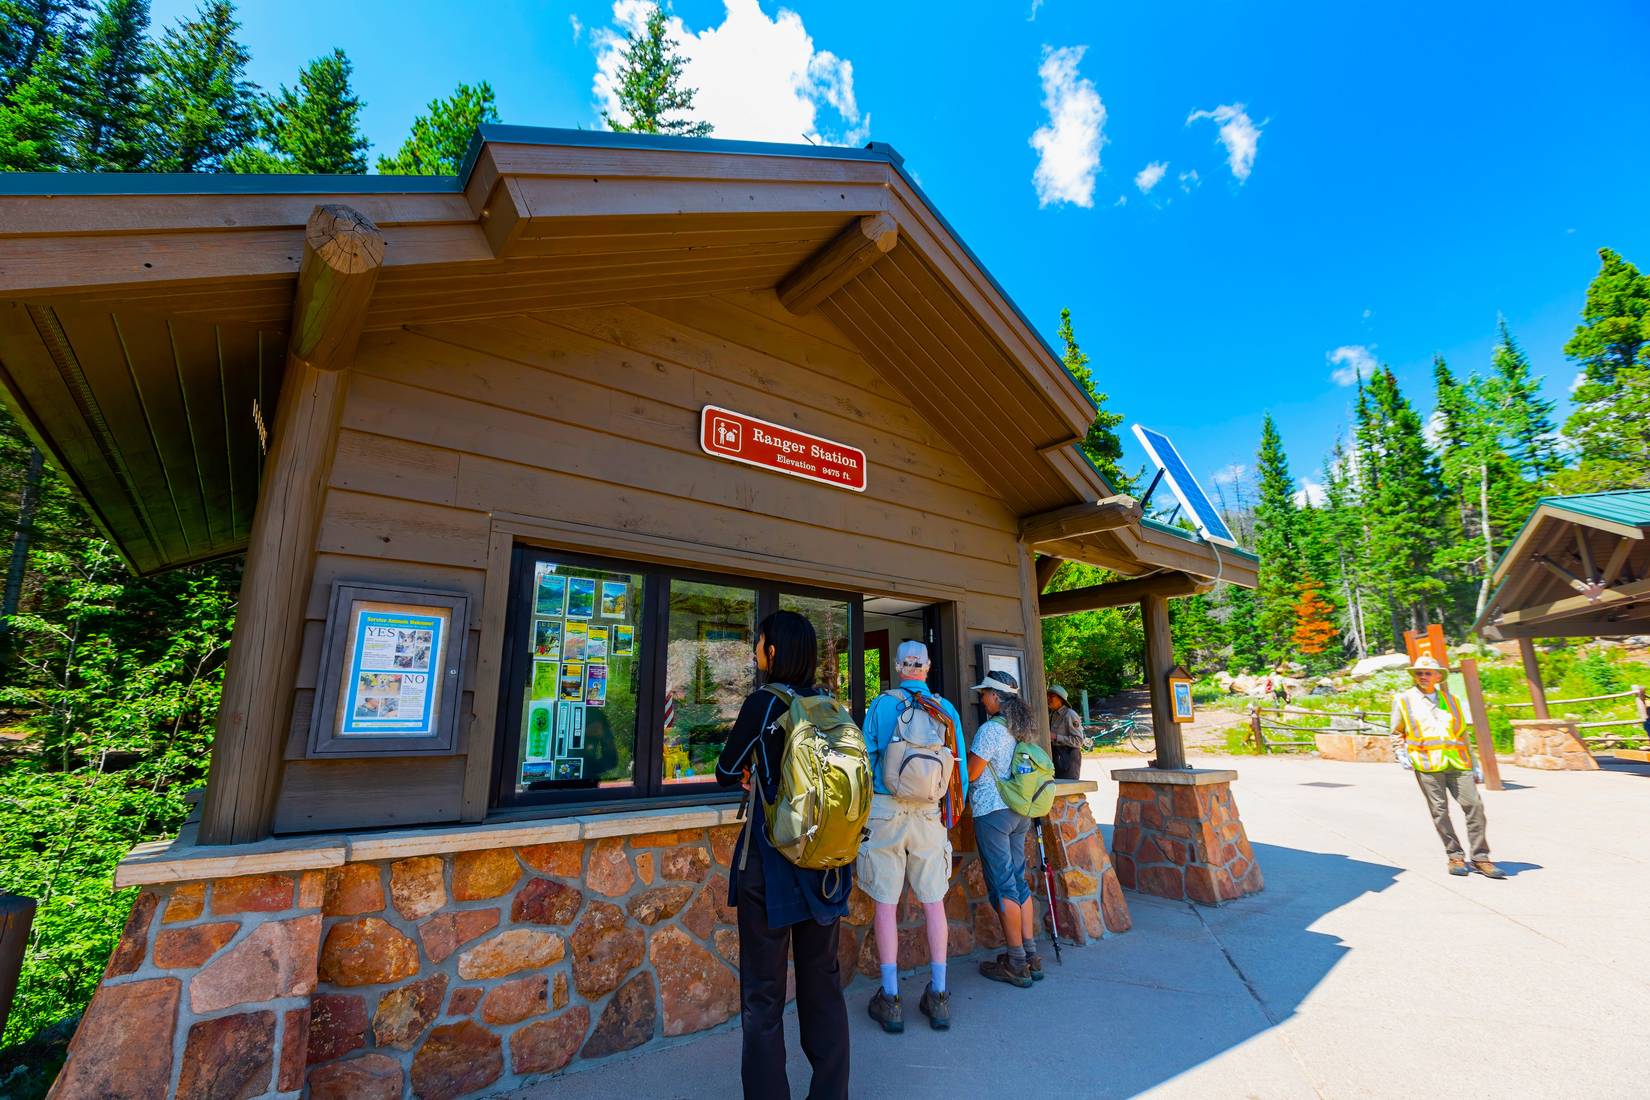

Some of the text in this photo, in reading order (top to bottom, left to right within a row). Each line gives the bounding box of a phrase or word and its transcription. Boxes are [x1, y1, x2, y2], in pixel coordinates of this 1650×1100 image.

[753, 428, 857, 468] Ranger Station
[777, 455, 851, 480] Elevation 9475 ft.
[368, 628, 396, 637] YES
[404, 675, 425, 684] NO
